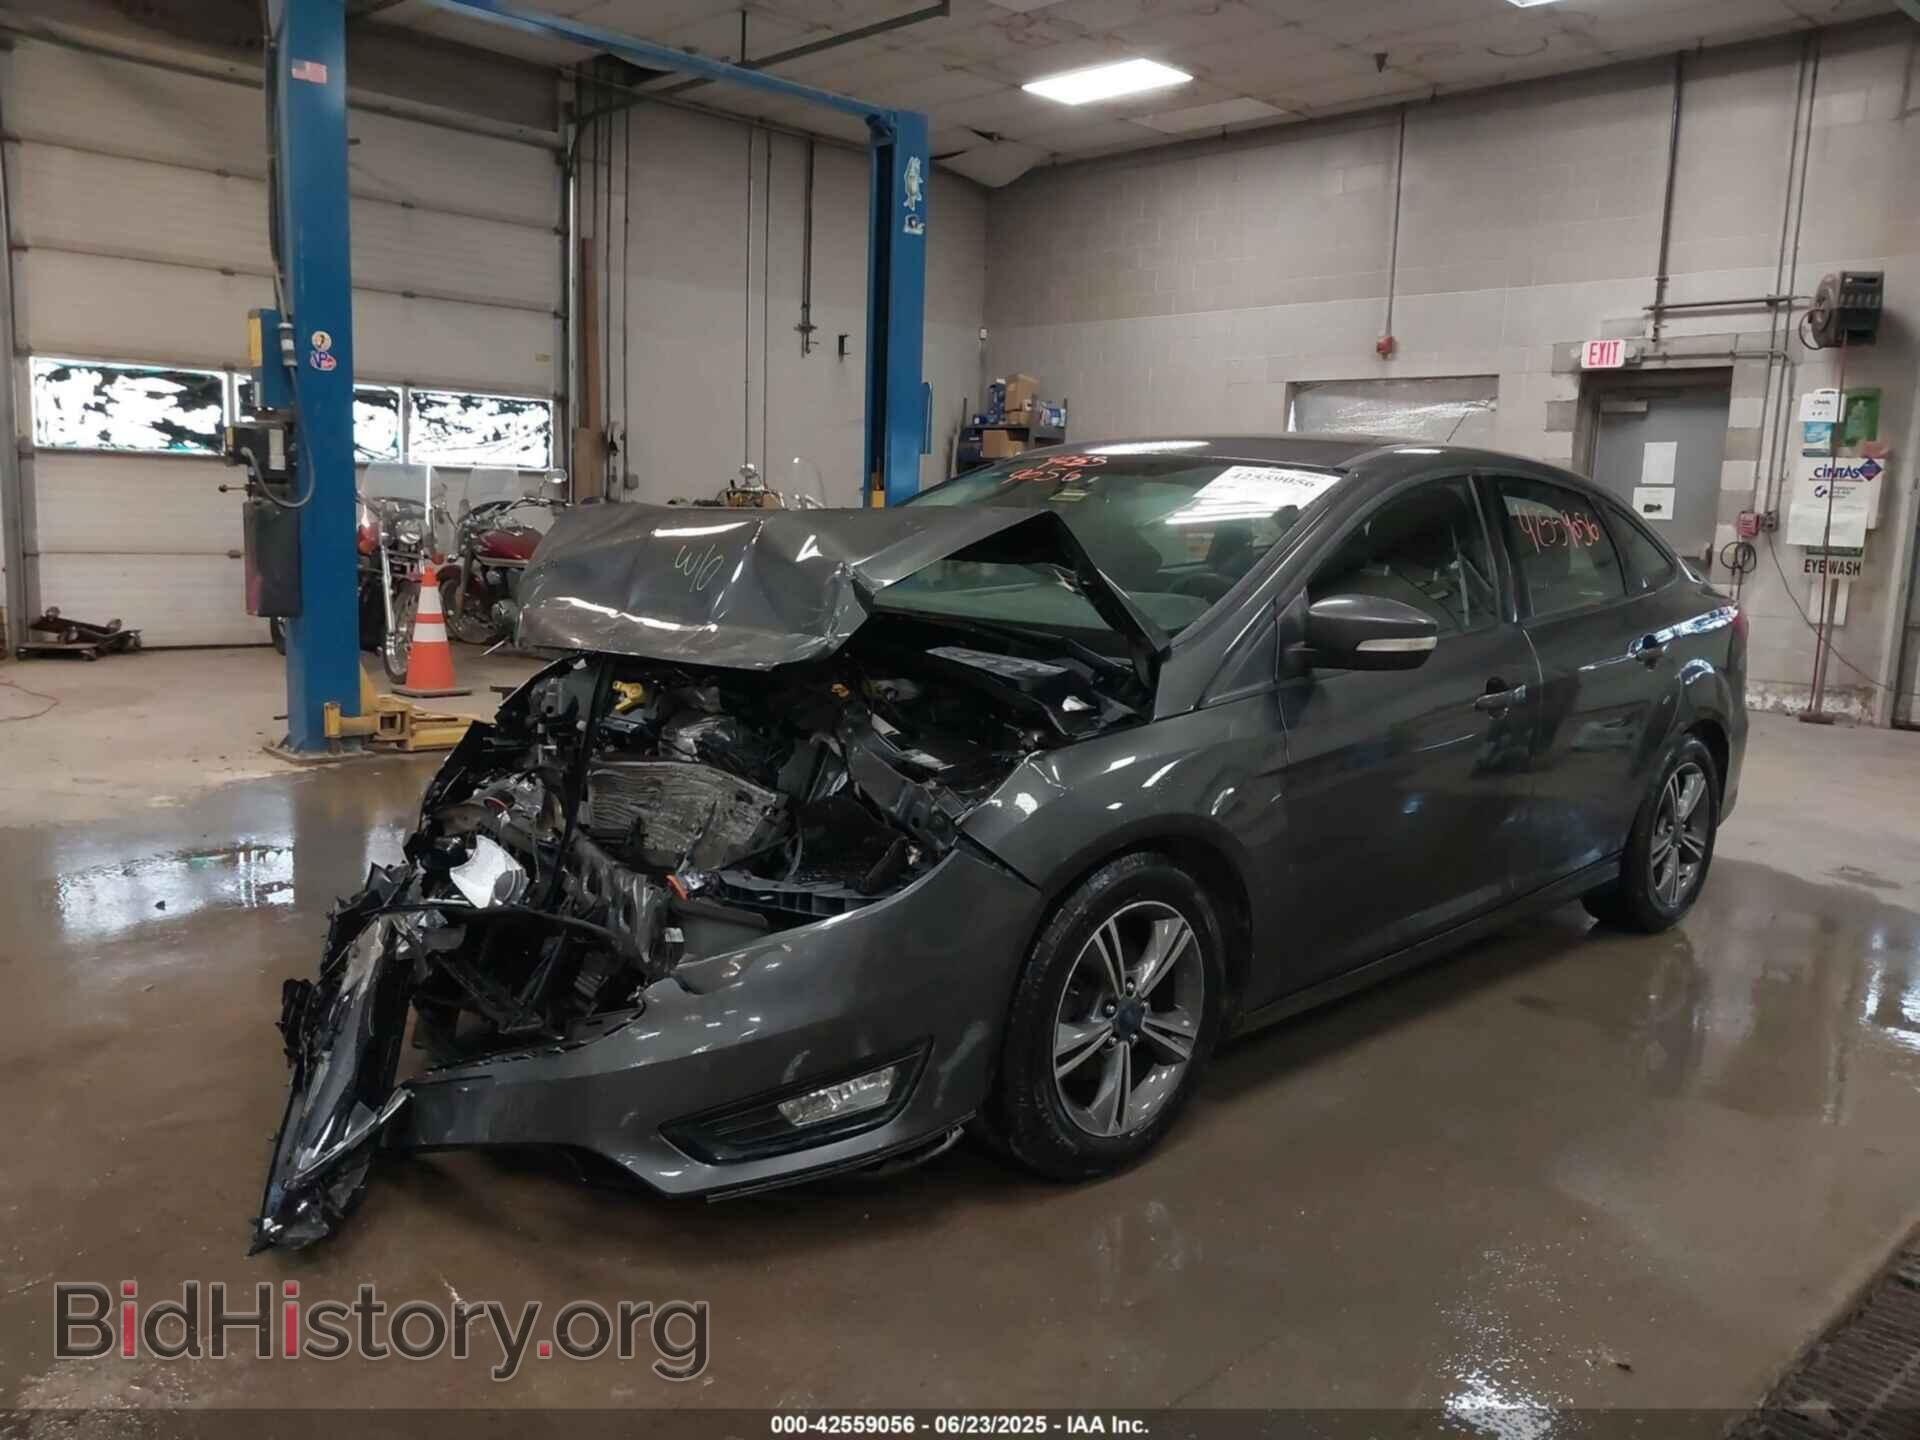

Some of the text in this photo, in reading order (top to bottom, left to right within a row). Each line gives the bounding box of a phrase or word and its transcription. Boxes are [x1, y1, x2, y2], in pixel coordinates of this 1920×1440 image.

[1588, 342, 1620, 366] EXIT
[1804, 559, 1862, 576] EYE WASH
